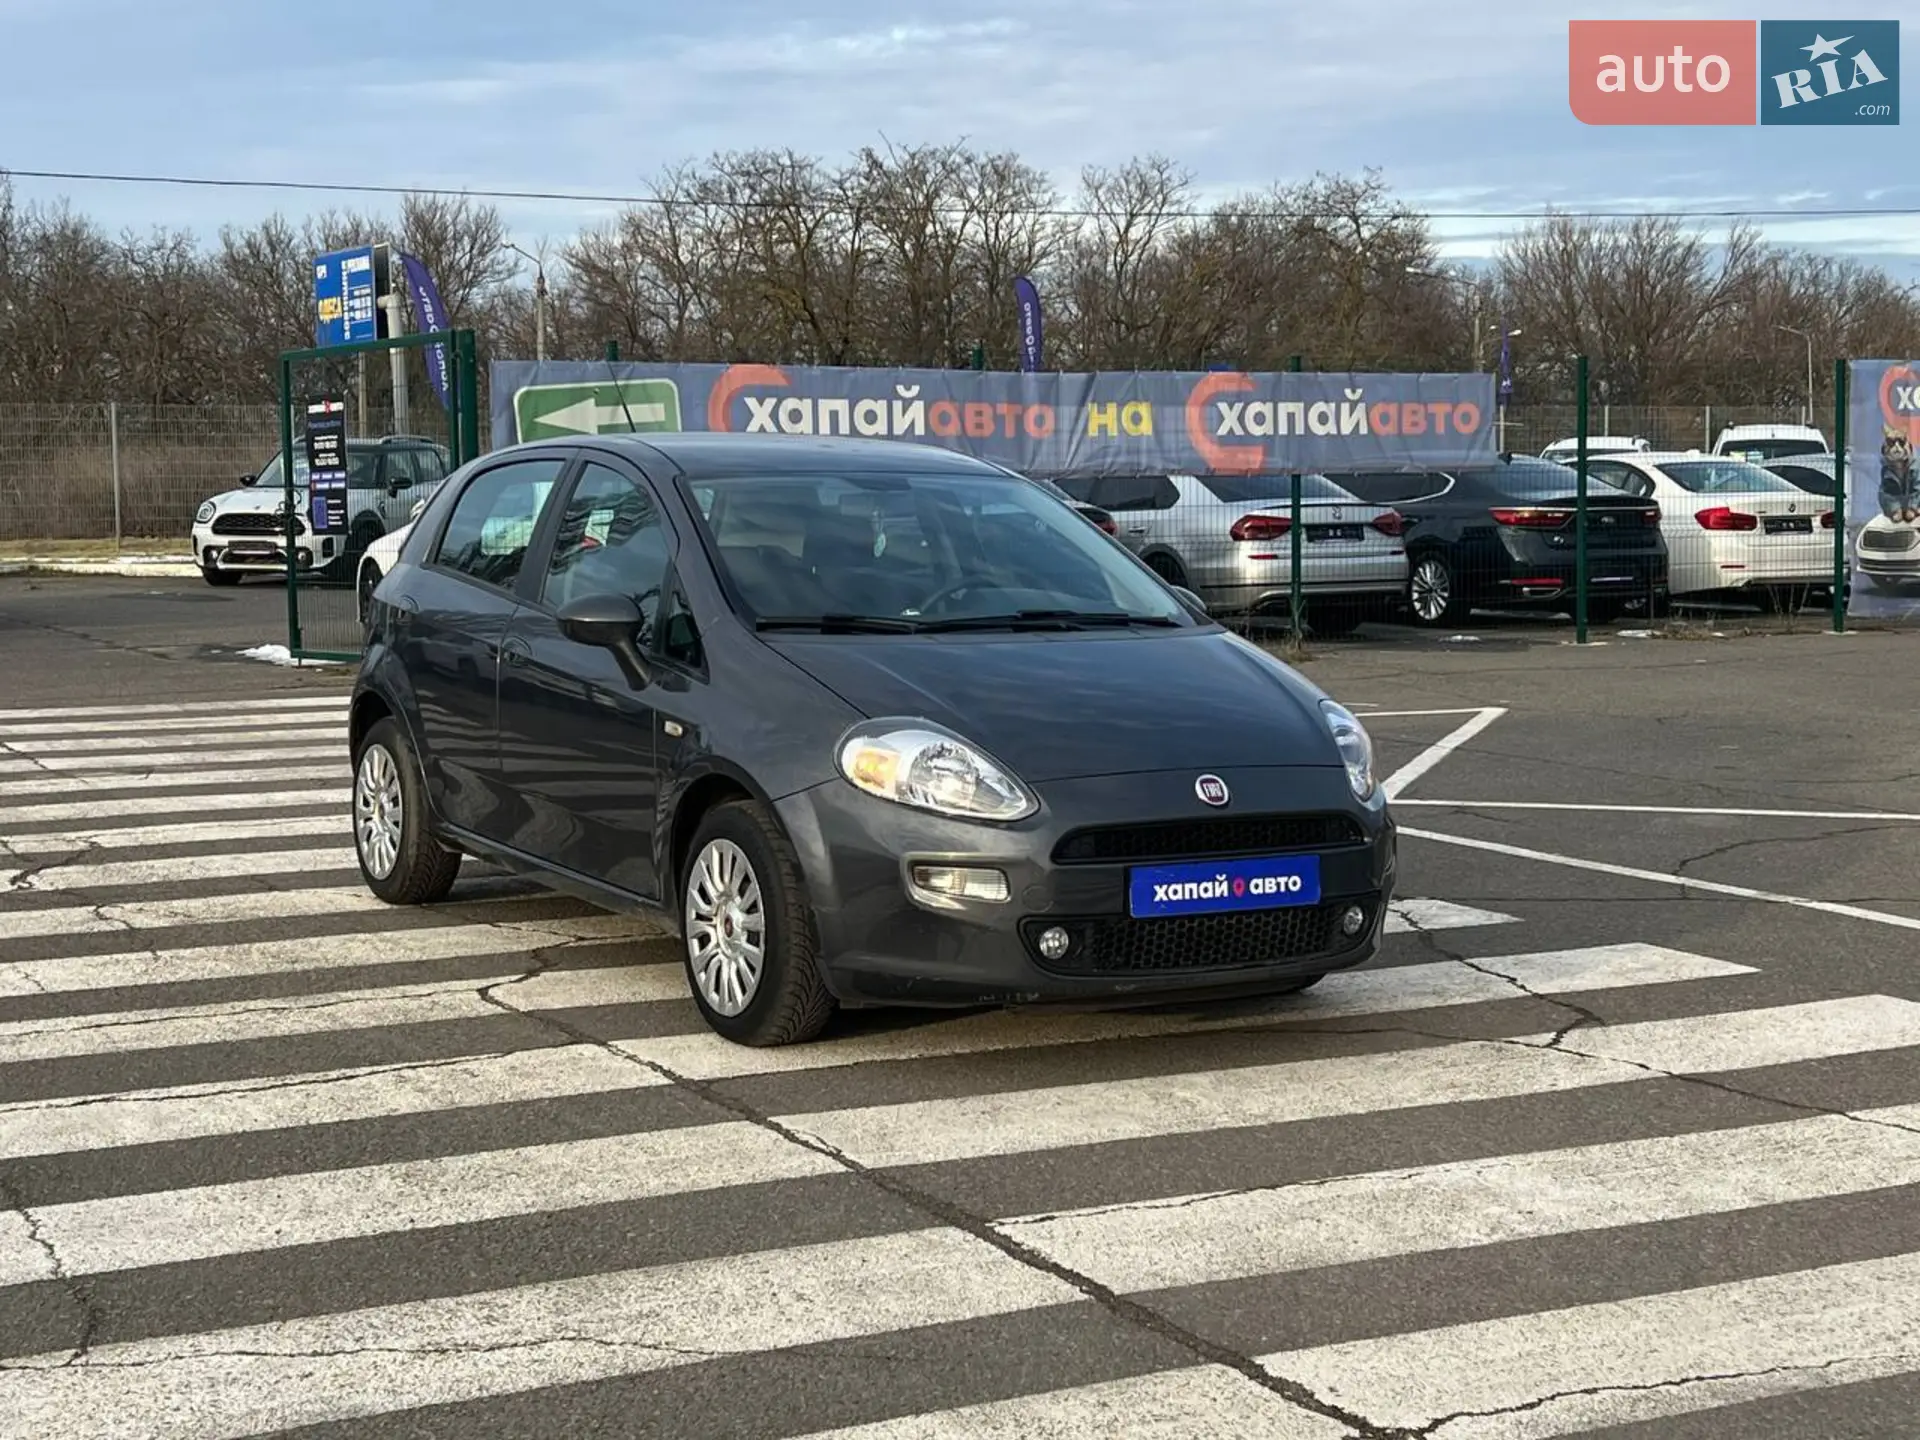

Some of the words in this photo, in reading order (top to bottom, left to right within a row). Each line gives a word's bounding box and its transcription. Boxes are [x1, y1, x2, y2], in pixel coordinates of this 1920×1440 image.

[1088, 400, 1153, 437] на
[1153, 874, 1229, 902] хапай
[1250, 875, 1302, 895] авто
